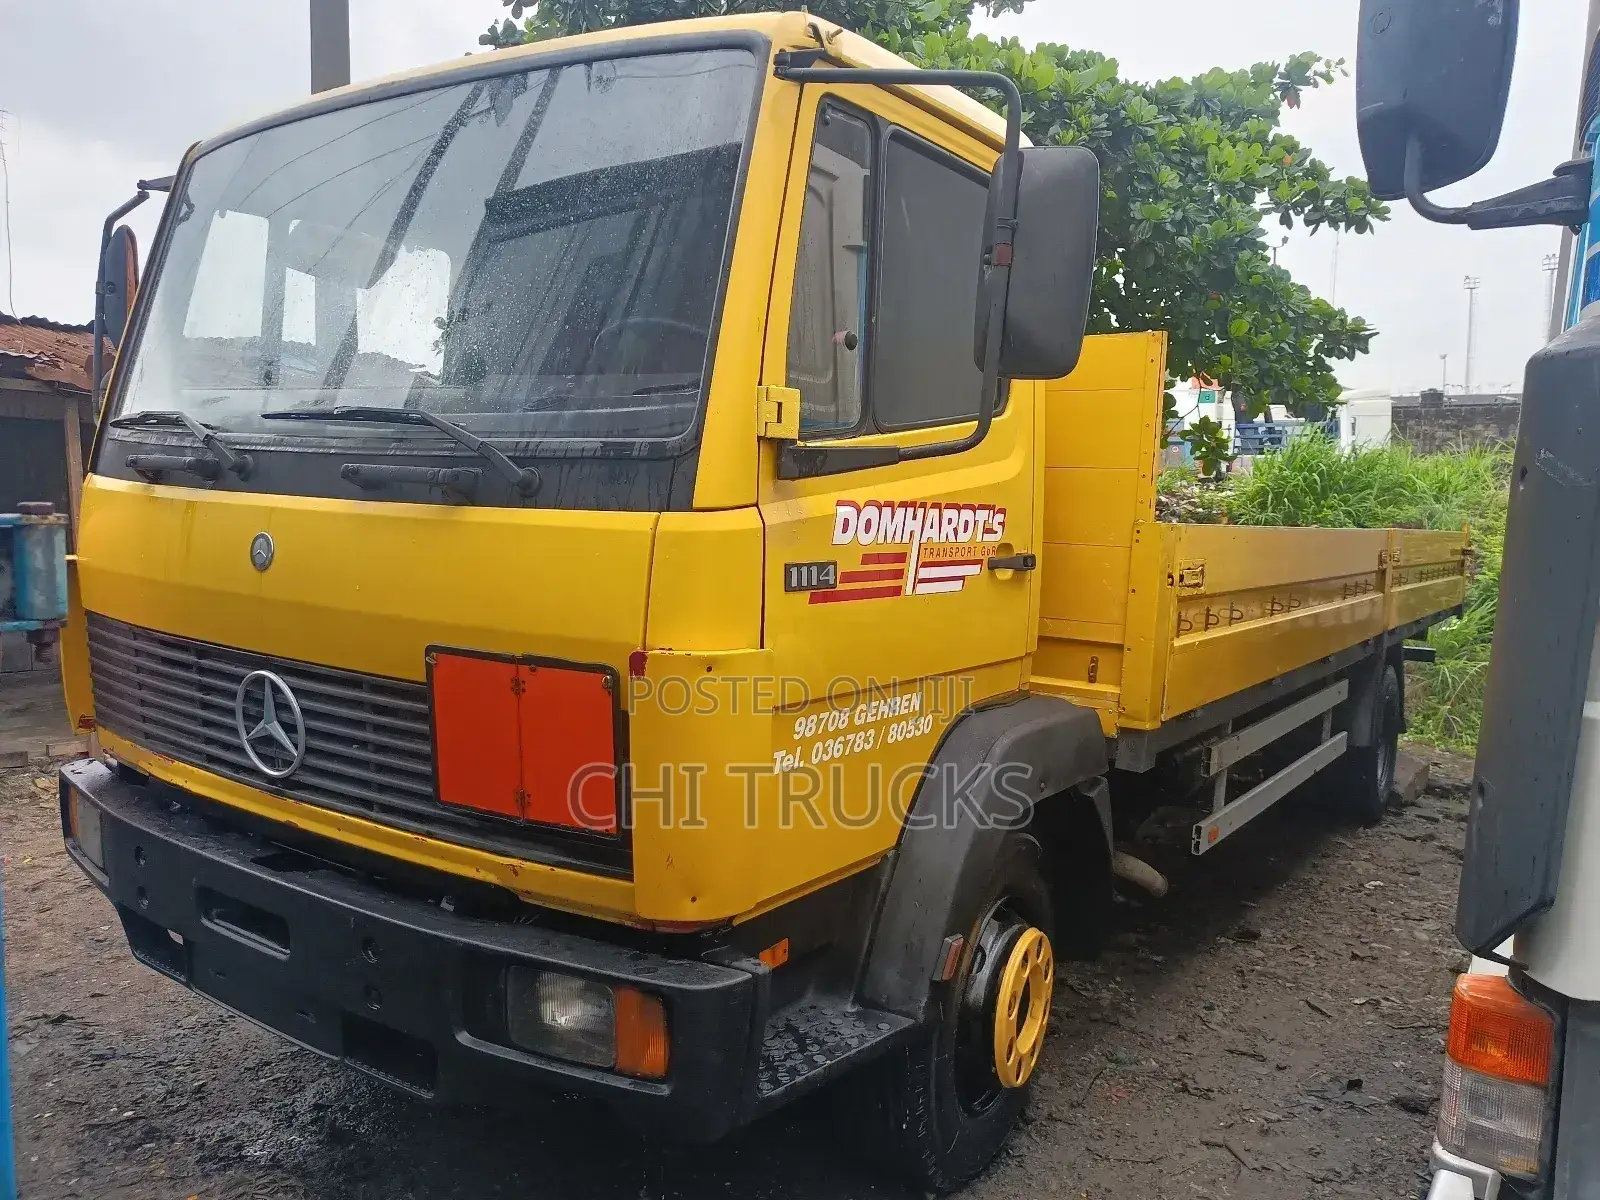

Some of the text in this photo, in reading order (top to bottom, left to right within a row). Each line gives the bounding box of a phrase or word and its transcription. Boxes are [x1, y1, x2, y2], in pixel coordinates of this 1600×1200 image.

[832, 500, 1007, 549] DOMHARDT'S
[789, 564, 836, 588] 1114
[923, 547, 977, 559] TRANSPORT
[793, 692, 922, 740] 98708 GEHREN
[773, 746, 804, 775] Tel.
[811, 728, 875, 765] 036783
[887, 714, 933, 744] 80530
